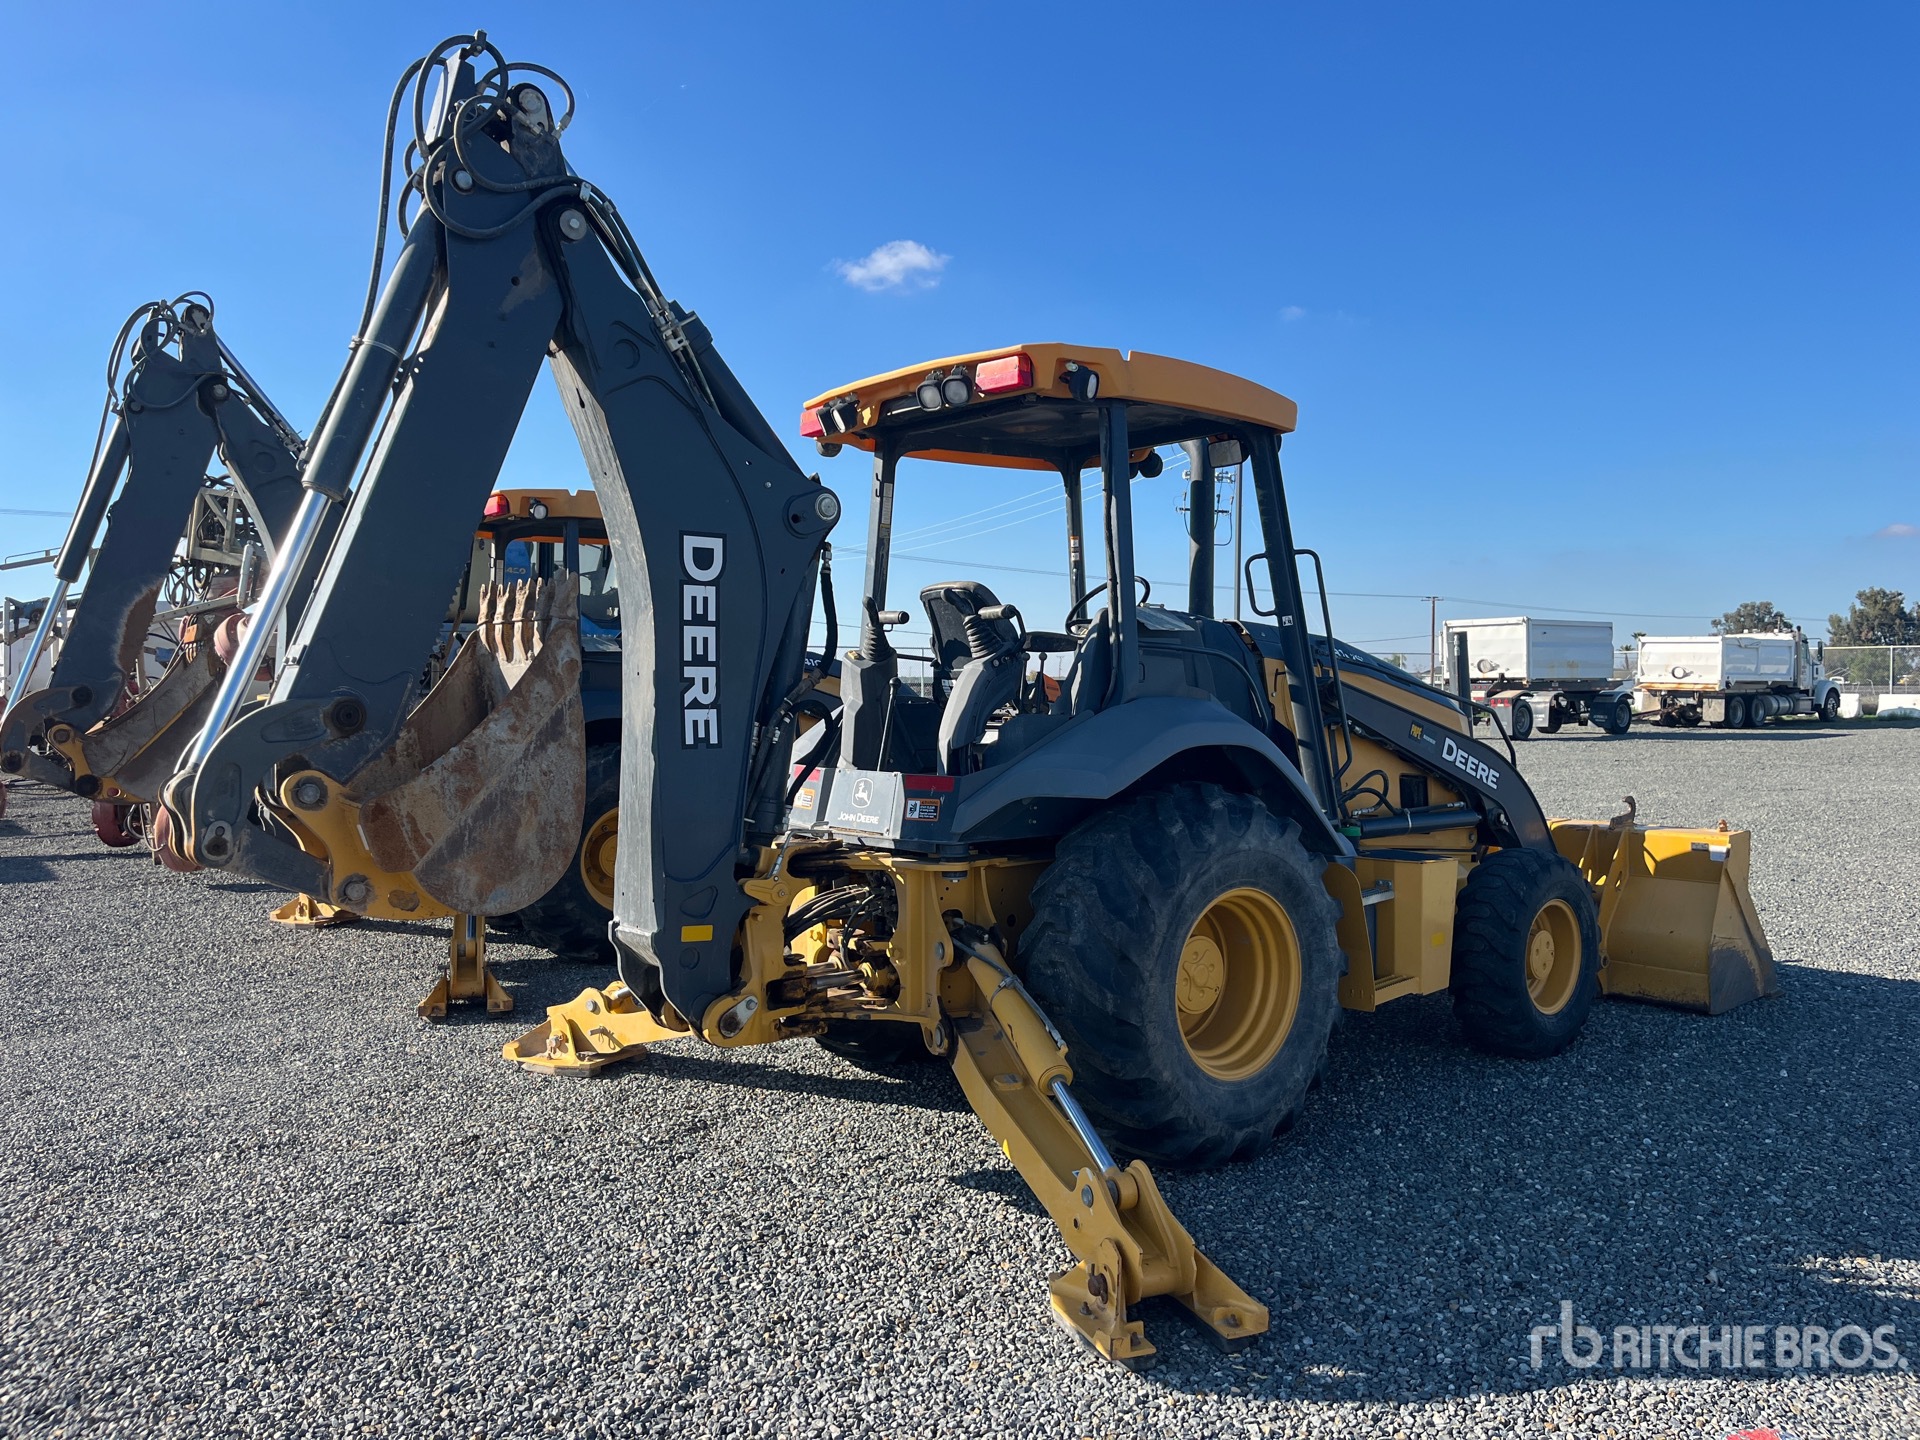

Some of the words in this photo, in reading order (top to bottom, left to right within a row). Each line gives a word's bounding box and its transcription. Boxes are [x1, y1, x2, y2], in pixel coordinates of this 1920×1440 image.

[683, 535, 723, 745] DEERE
[1441, 737, 1501, 790] DEERE
[838, 812, 855, 822] JOHN
[856, 814, 879, 824] DEERE
